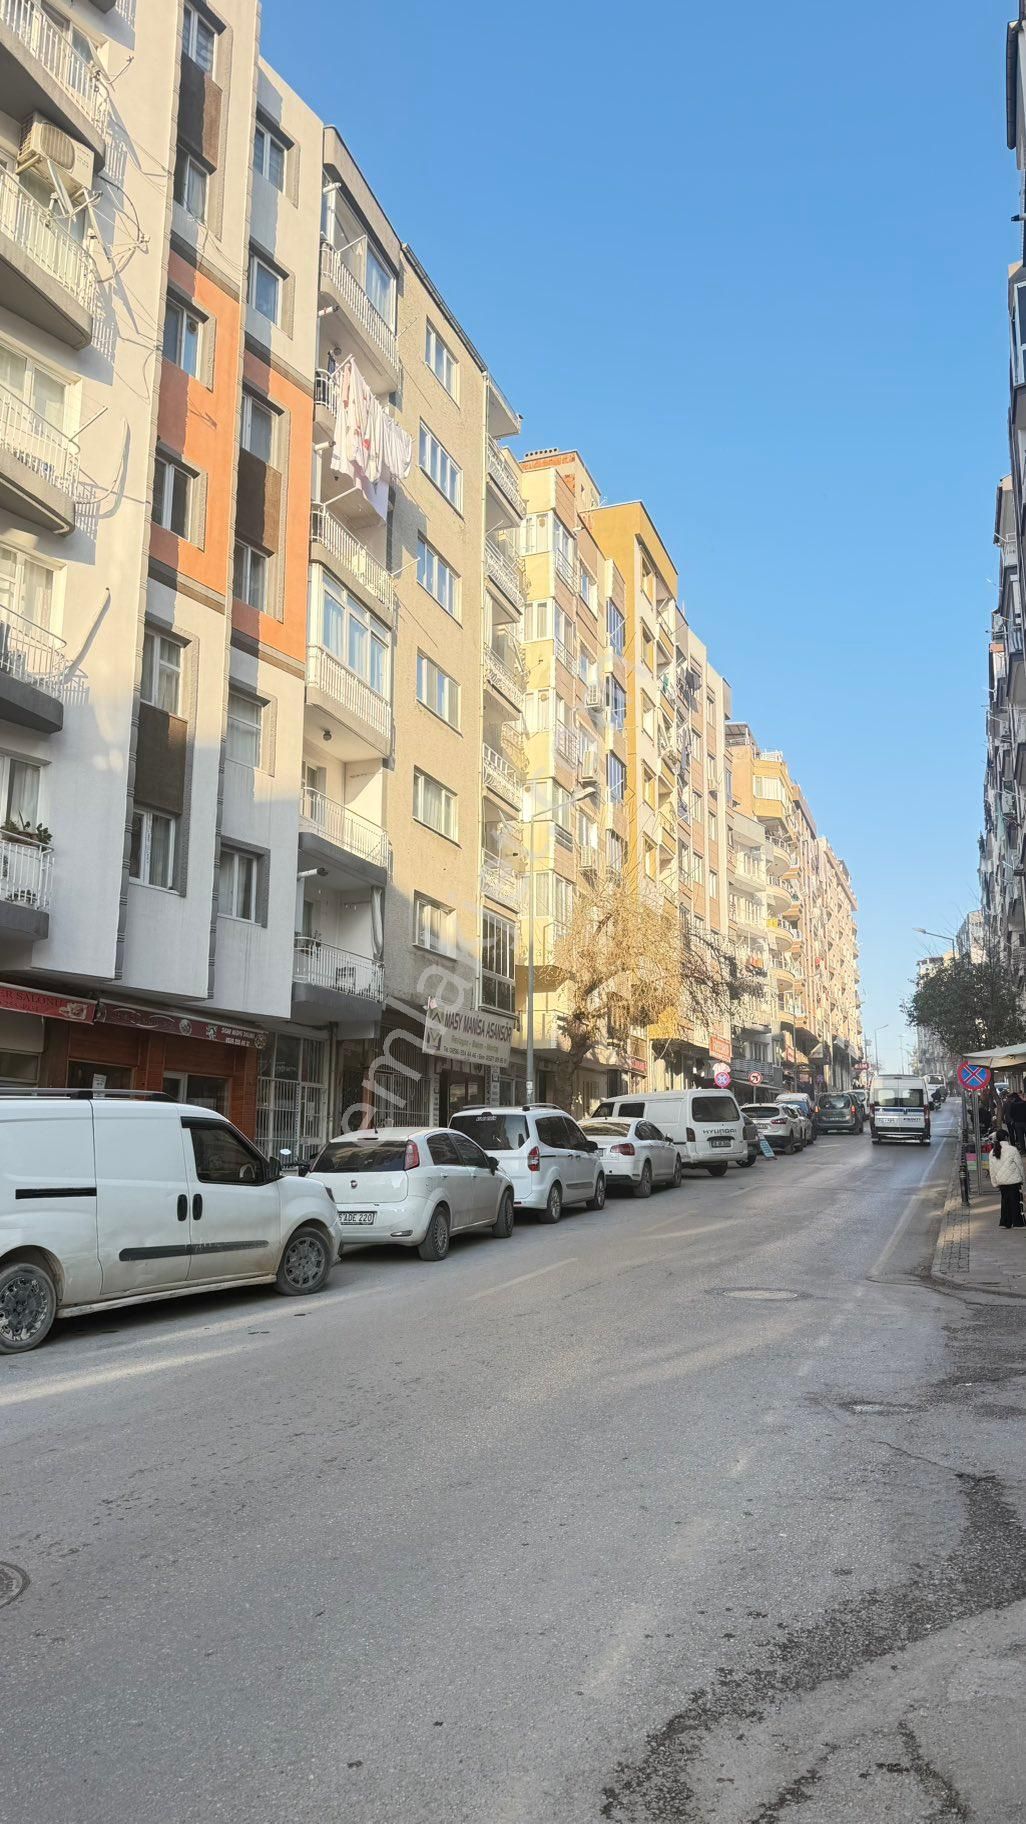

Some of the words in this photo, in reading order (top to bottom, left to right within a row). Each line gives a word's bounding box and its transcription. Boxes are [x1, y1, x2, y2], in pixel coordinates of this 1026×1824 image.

[445, 1011, 463, 1031] MASY
[464, 1014, 485, 1037] MANİSA
[486, 1021, 512, 1042] ASANSÖR
[358, 1213, 372, 1222] 220
